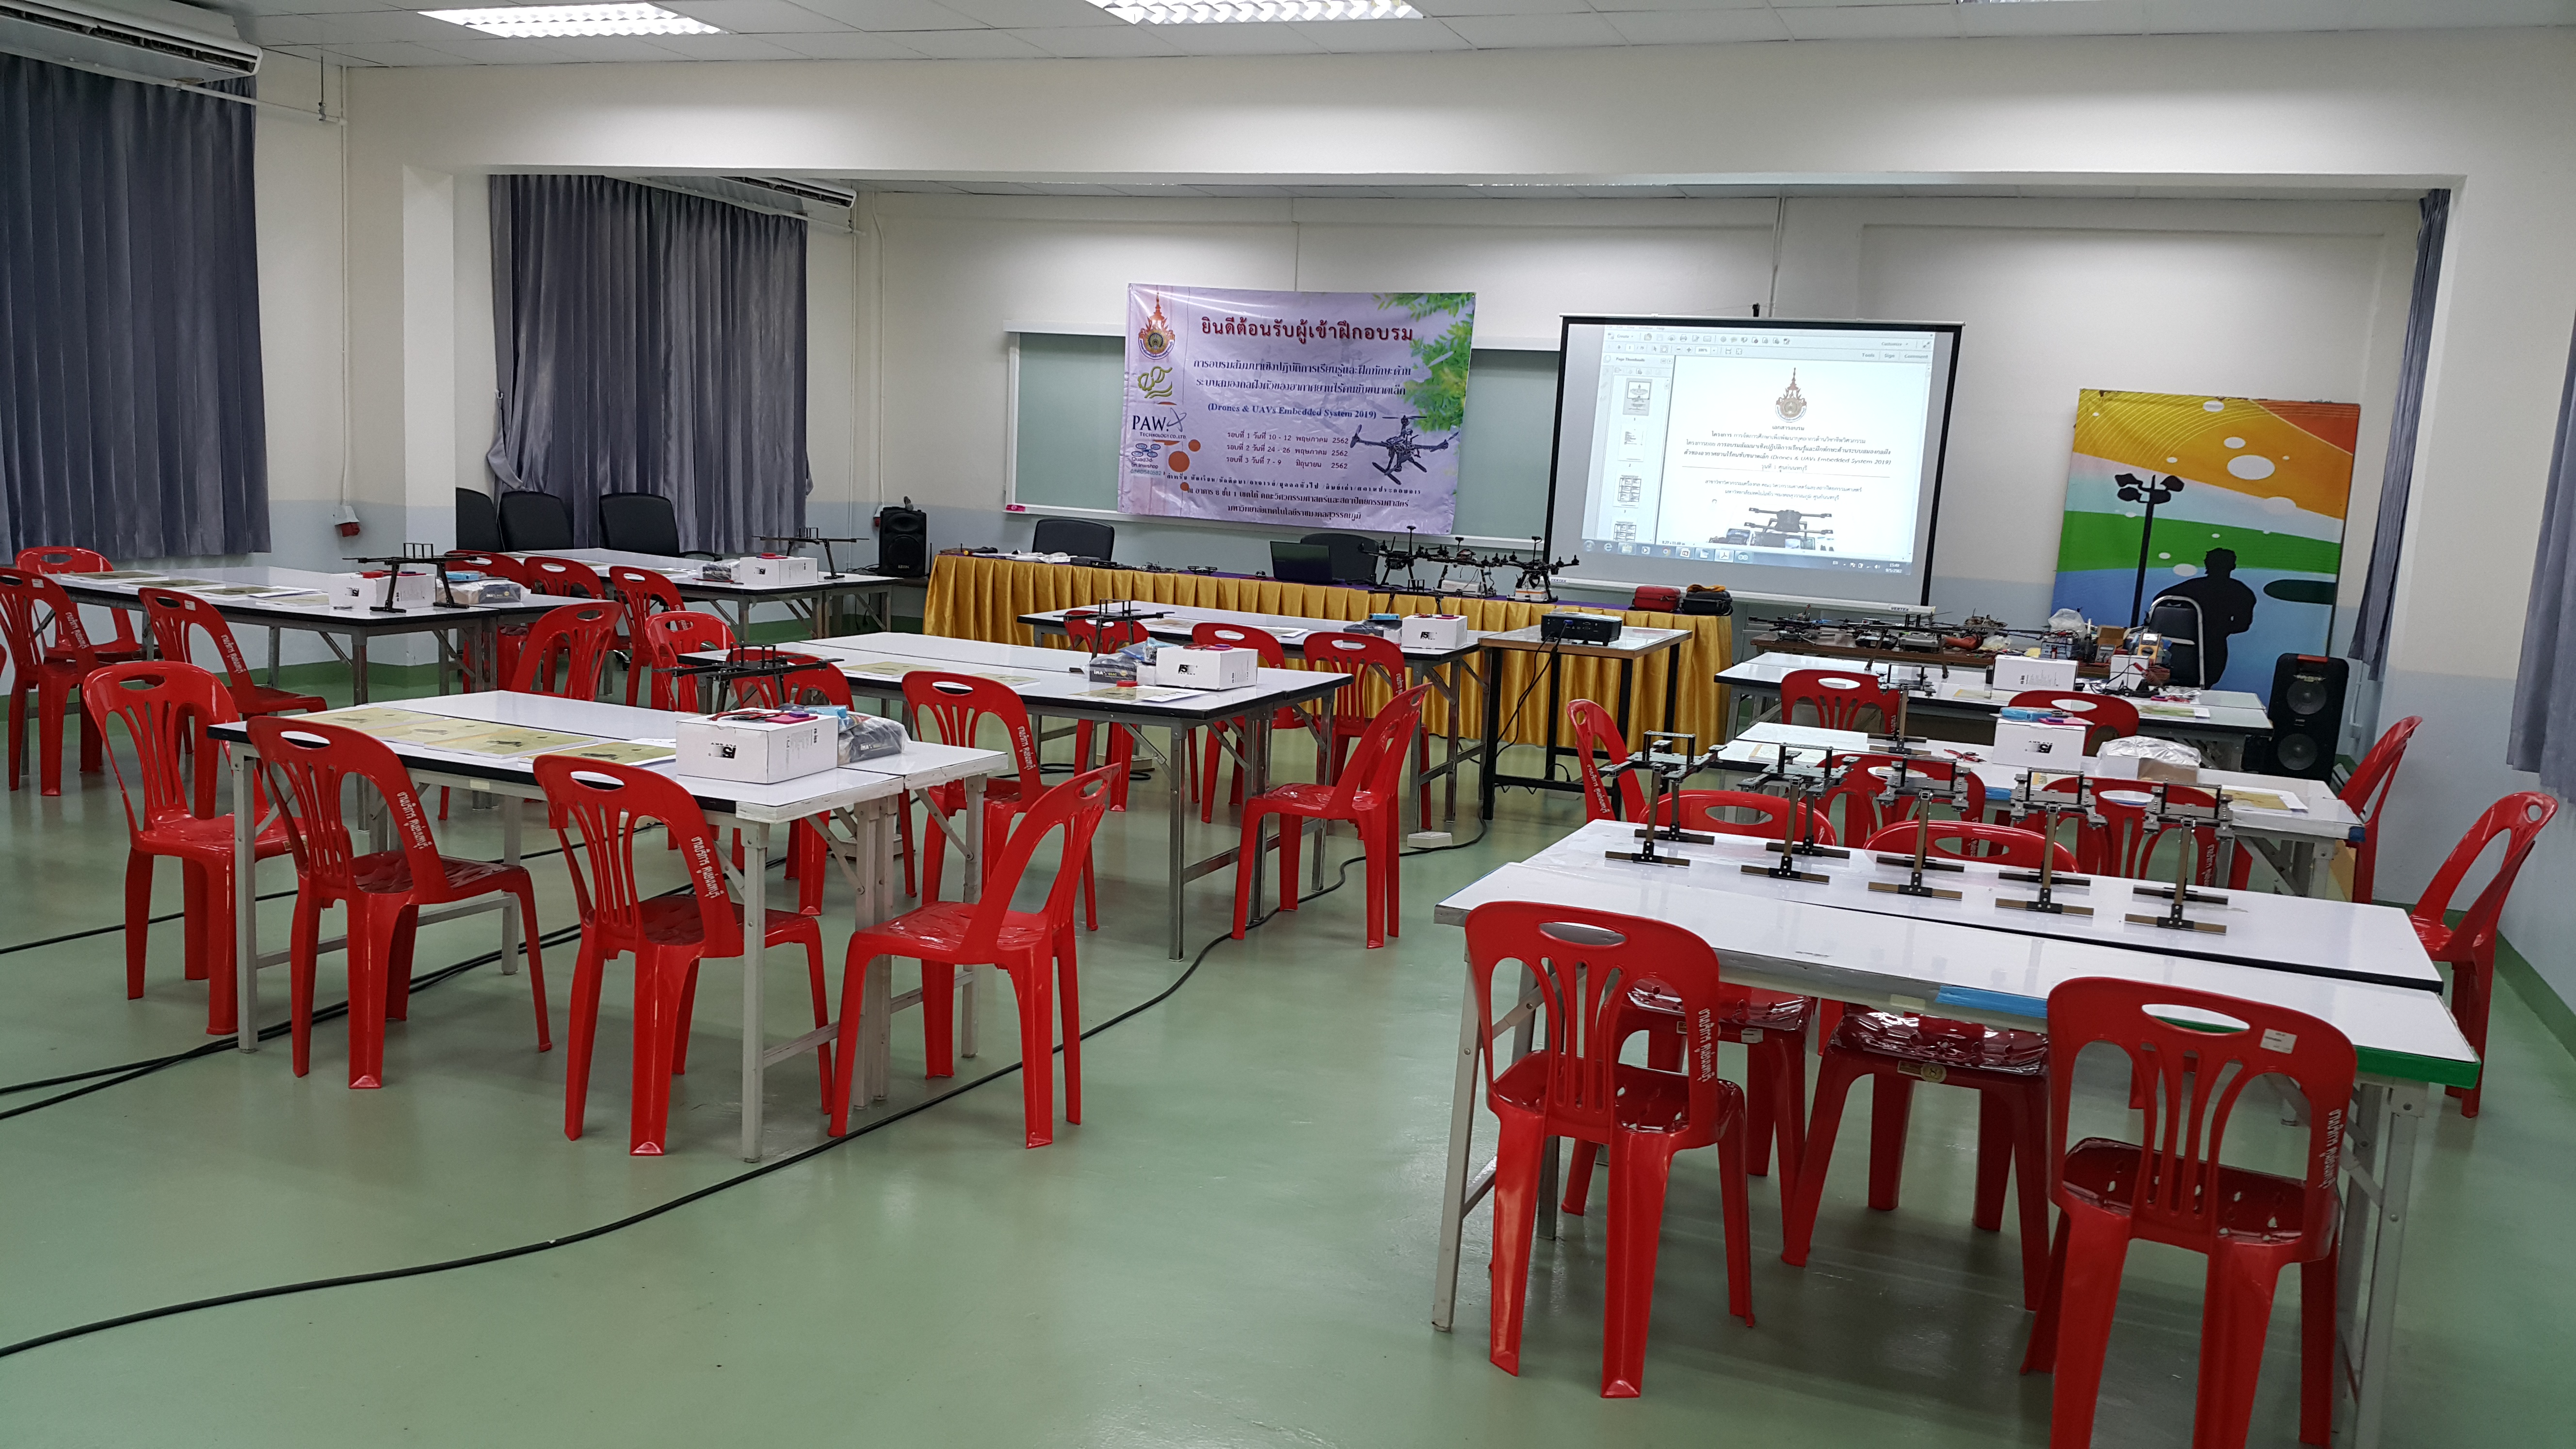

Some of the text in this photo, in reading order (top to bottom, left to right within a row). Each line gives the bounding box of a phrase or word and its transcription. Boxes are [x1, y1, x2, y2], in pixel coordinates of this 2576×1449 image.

[1201, 316, 1414, 344] ยินดีต้อนรับผู้เข้าฝึกอบรม
[1208, 403, 1240, 412] (Drones
[1252, 405, 1276, 414] UAVs
[1278, 406, 1322, 416] Embedded
[1323, 409, 1352, 419] System
[1354, 410, 1377, 419] 2019)
[1227, 430, 1245, 439] รอบที่
[1253, 431, 1266, 440] วันที่
[1296, 435, 1328, 444] พฤษภาคม
[1226, 441, 1243, 451] รอบที่
[1252, 443, 1265, 452] วันที่
[1295, 448, 1327, 456] พฤษภาคม
[1226, 453, 1243, 463] รอบที่
[1251, 455, 1264, 465] วันที่
[1296, 458, 1322, 469] มิถุนายน
[1222, 487, 1231, 496] ชั้น
[1227, 504, 1362, 522] มหาวิทยาลัยเทคโนโลยีราชมงคลสุวรรณภูมิ
[397, 791, 417, 819] งานบริการ
[691, 836, 711, 866] งานบริการ
[1698, 1008, 1715, 1043] งานบริการ
